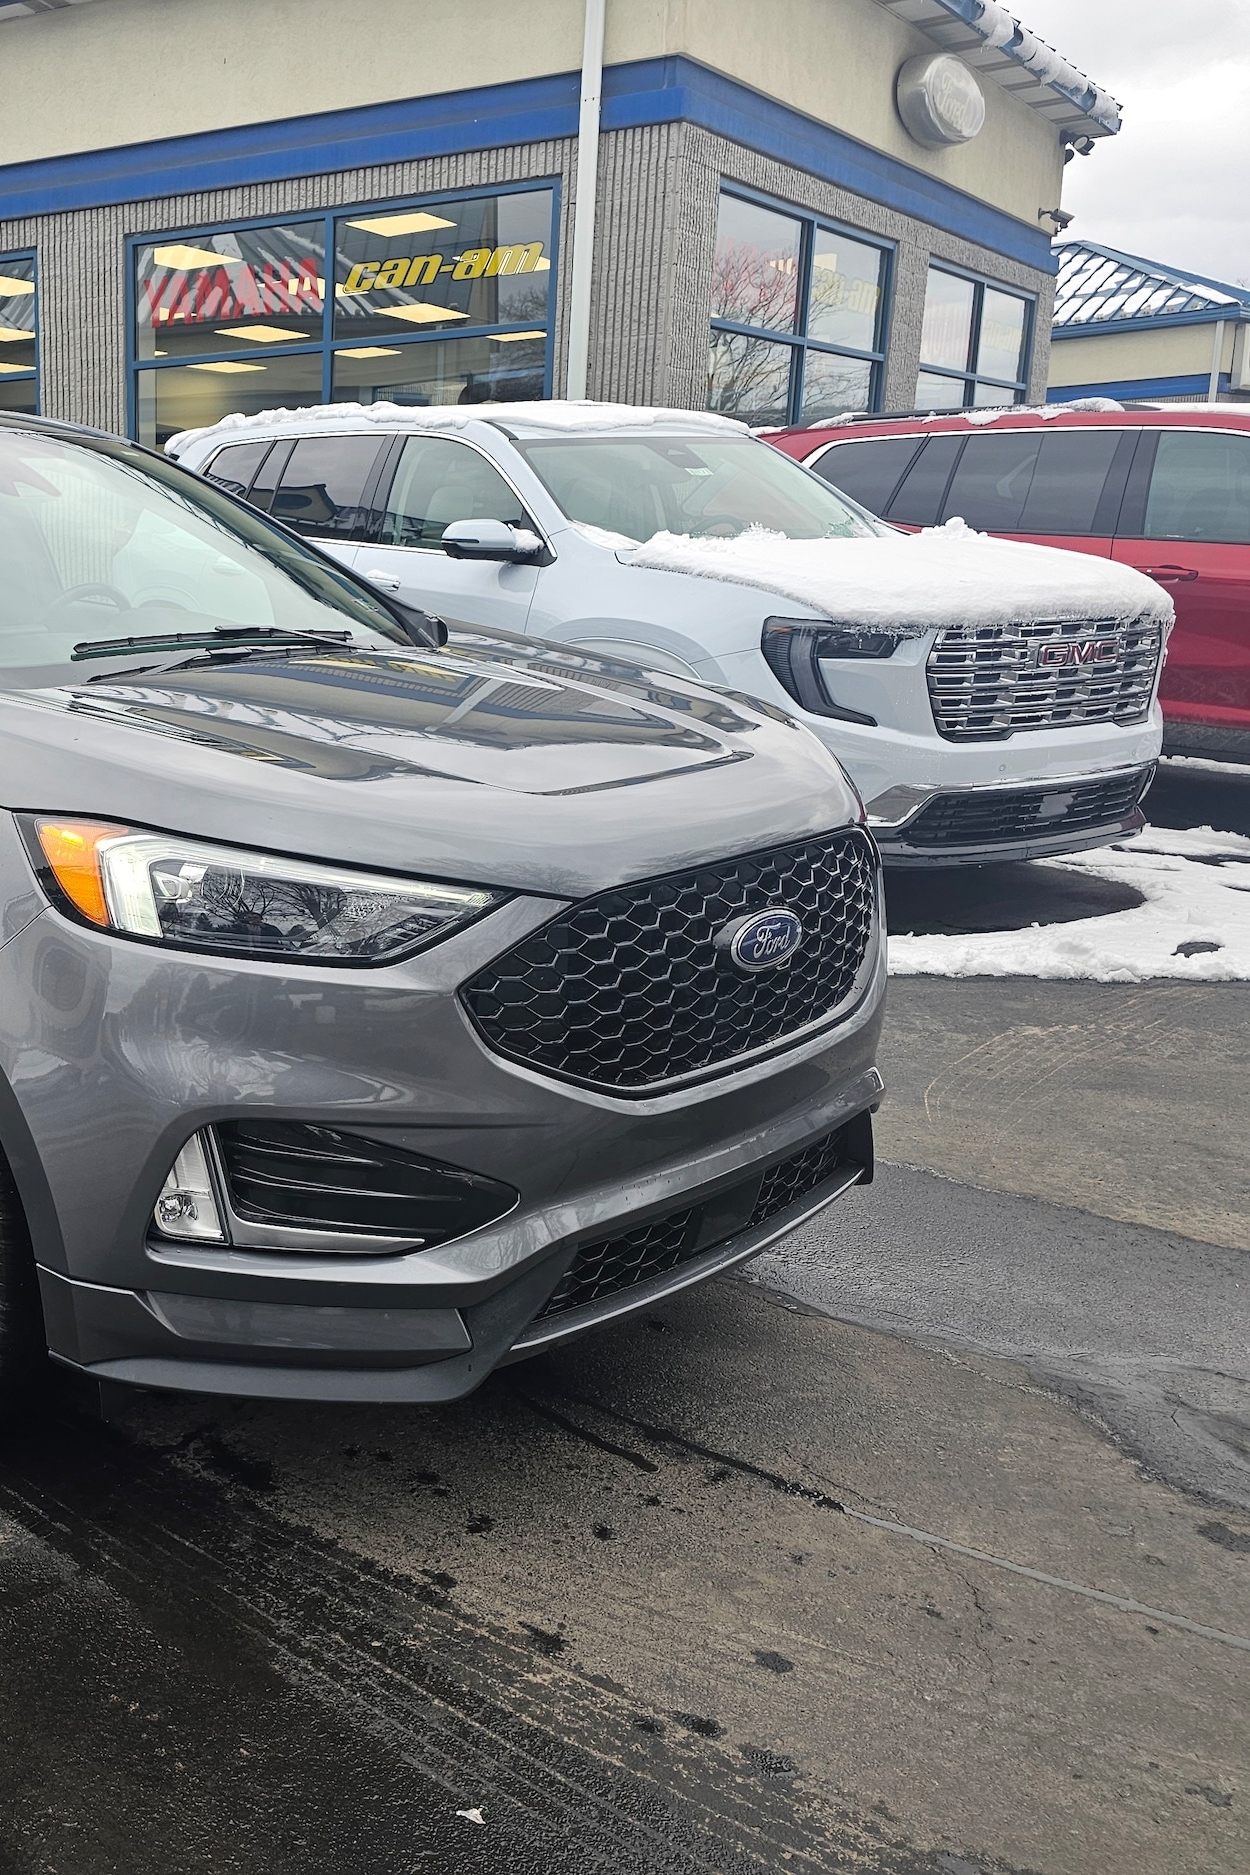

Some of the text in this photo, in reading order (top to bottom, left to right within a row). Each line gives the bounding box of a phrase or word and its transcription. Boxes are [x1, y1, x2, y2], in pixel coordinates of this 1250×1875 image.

[342, 241, 546, 295] can-am
[144, 257, 325, 328] YAMAHA
[1038, 639, 1119, 667] GMC
[753, 922, 791, 959] Ford
